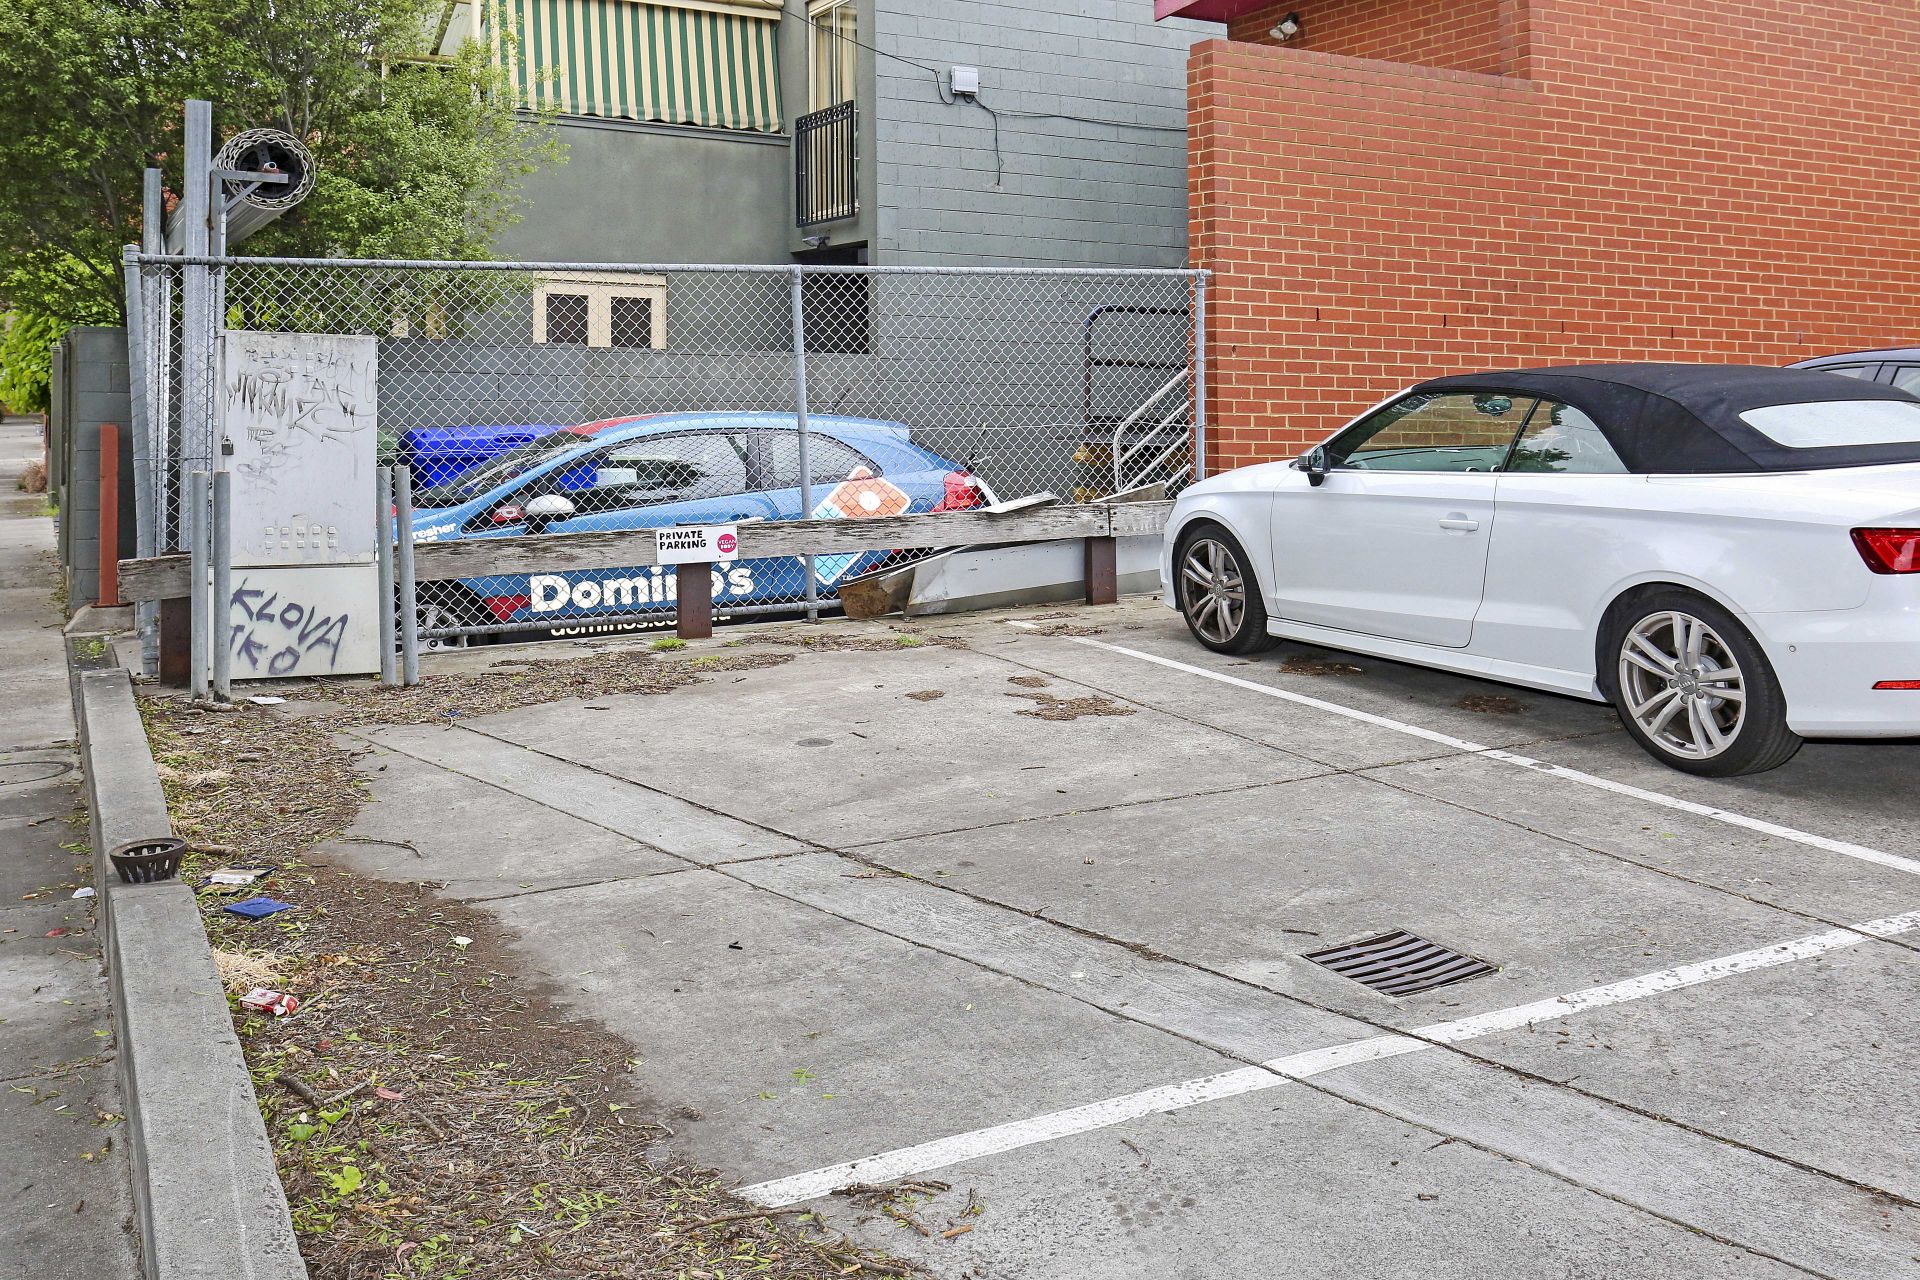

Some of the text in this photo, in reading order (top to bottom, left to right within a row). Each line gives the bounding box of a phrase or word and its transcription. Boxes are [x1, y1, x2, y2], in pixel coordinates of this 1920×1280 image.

[412, 522, 456, 540] resher
[659, 530, 703, 541] PRIVATE
[659, 539, 707, 550] PARKING
